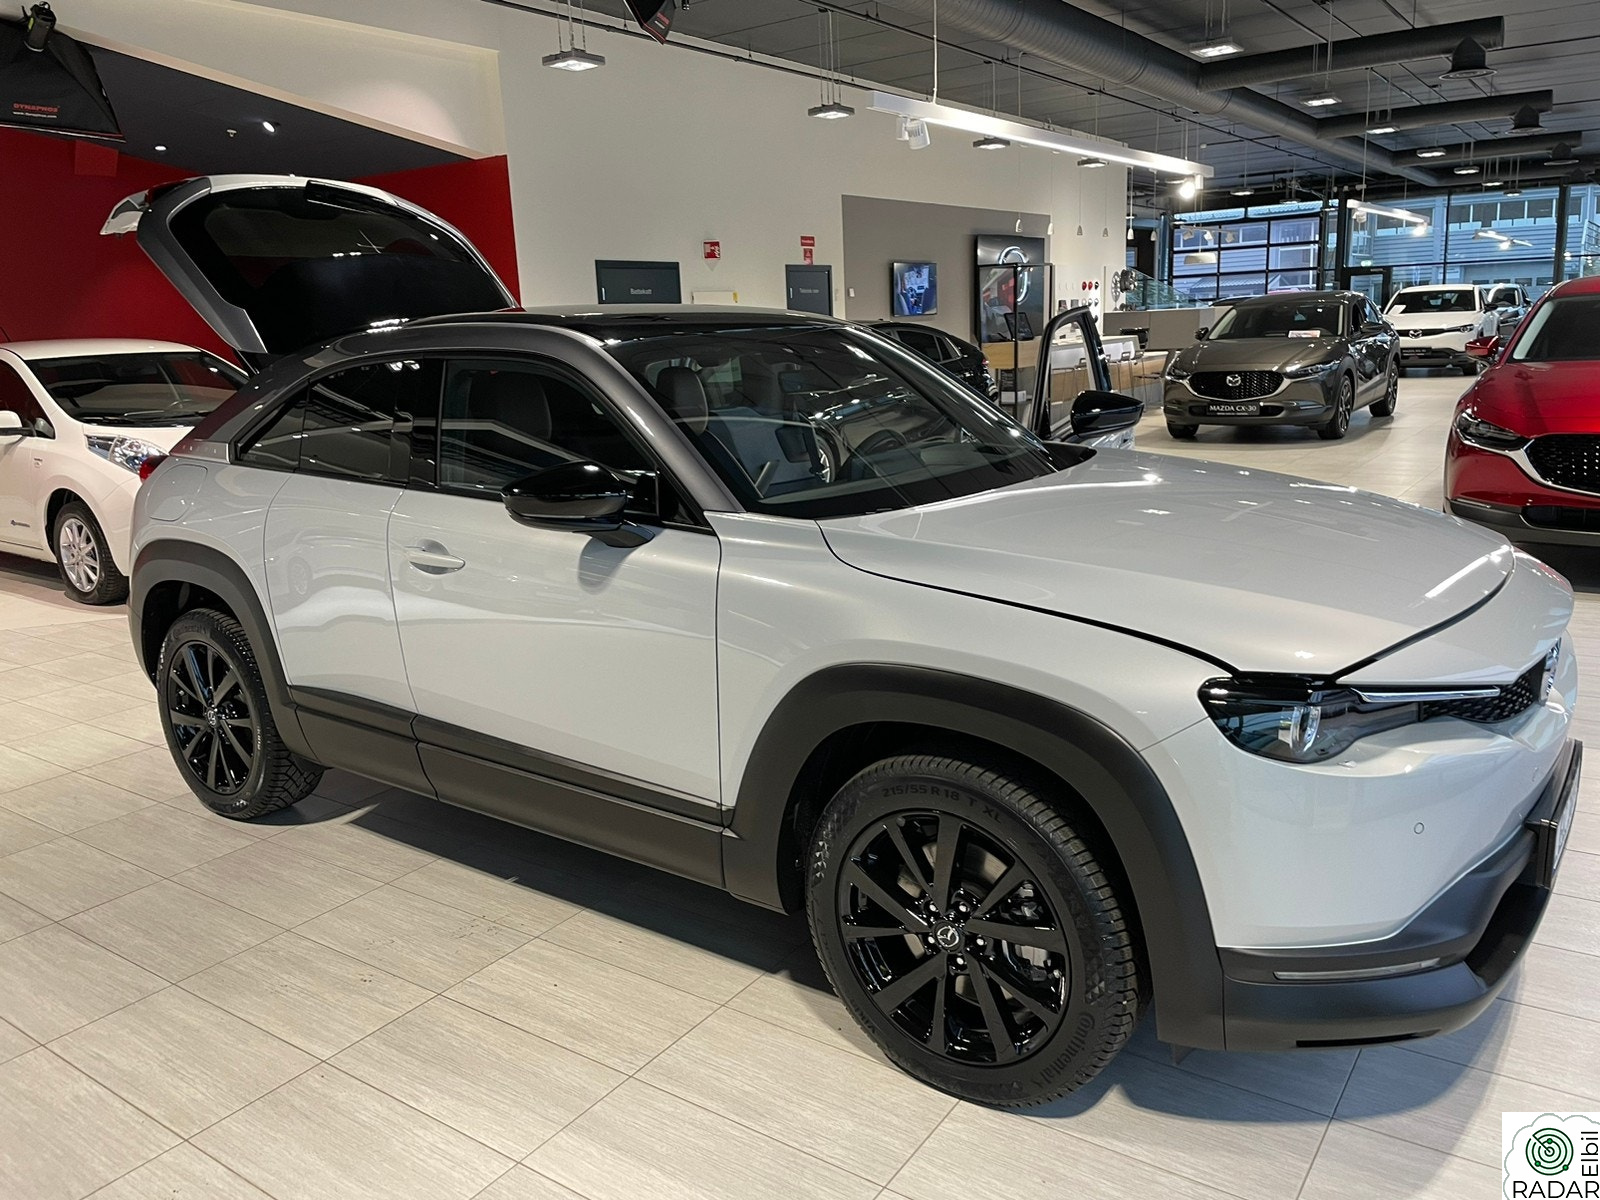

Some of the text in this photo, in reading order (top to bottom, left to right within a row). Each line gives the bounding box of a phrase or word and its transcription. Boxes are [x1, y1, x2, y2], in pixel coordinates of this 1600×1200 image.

[881, 784, 928, 798] 215/55
[930, 785, 941, 796] R
[943, 788, 960, 801] 18
[1039, 1011, 1097, 1085] Continental
